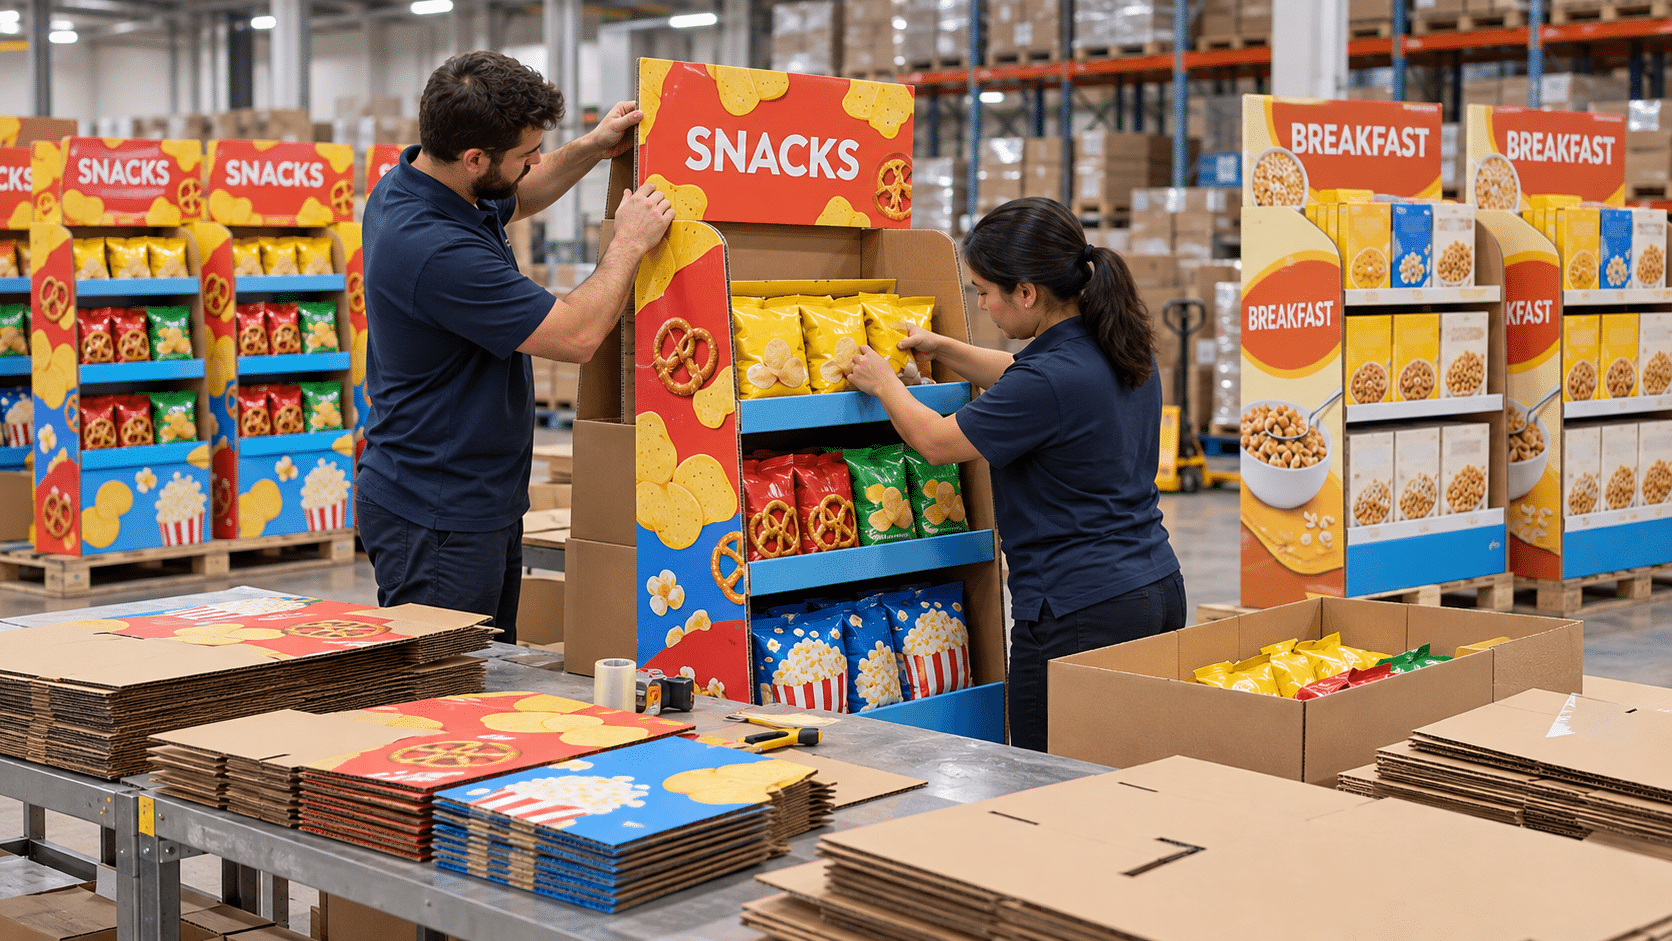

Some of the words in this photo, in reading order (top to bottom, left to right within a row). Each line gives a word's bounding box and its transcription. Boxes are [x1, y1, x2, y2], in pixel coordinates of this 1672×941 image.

[684, 125, 860, 181] SNACKS
[1291, 122, 1430, 157] BREAKFAST
[1507, 130, 1616, 165] BREAKFAST
[77, 158, 170, 186] SNACKS
[225, 159, 325, 188] SNACKS
[1248, 300, 1334, 331] BREAKFAST
